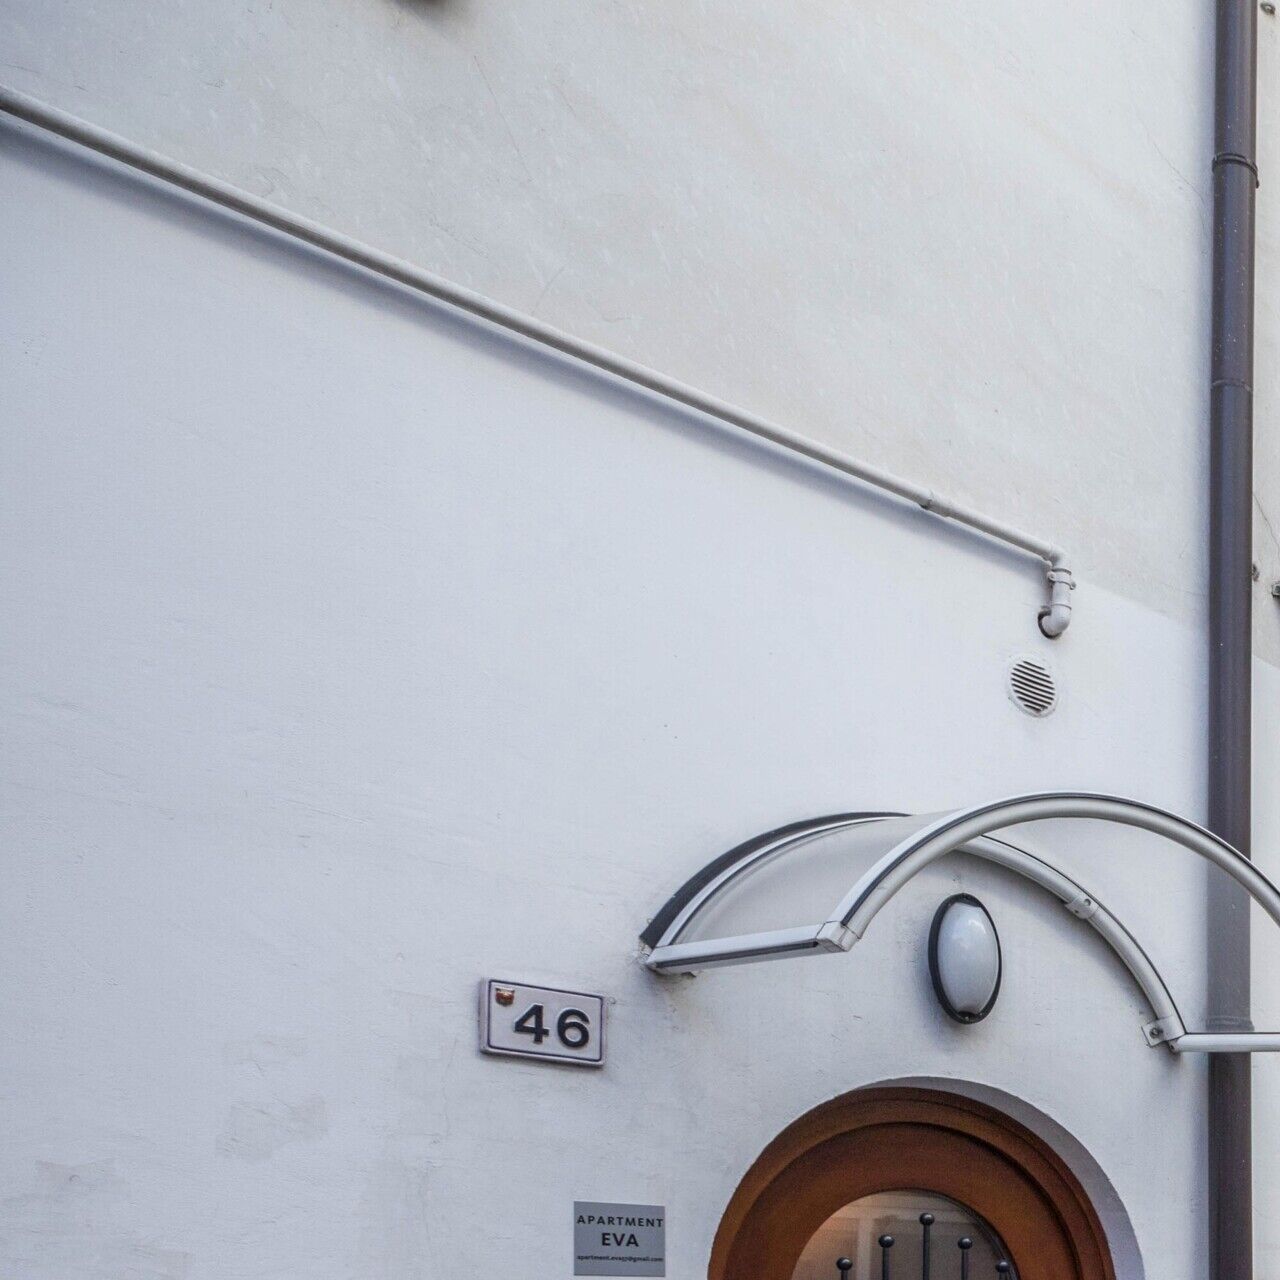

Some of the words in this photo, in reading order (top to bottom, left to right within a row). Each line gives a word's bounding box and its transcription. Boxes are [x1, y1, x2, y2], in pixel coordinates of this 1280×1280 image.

[514, 1003, 590, 1048] 46
[577, 1215, 664, 1228] APARTMENT
[601, 1232, 639, 1247] EVA
